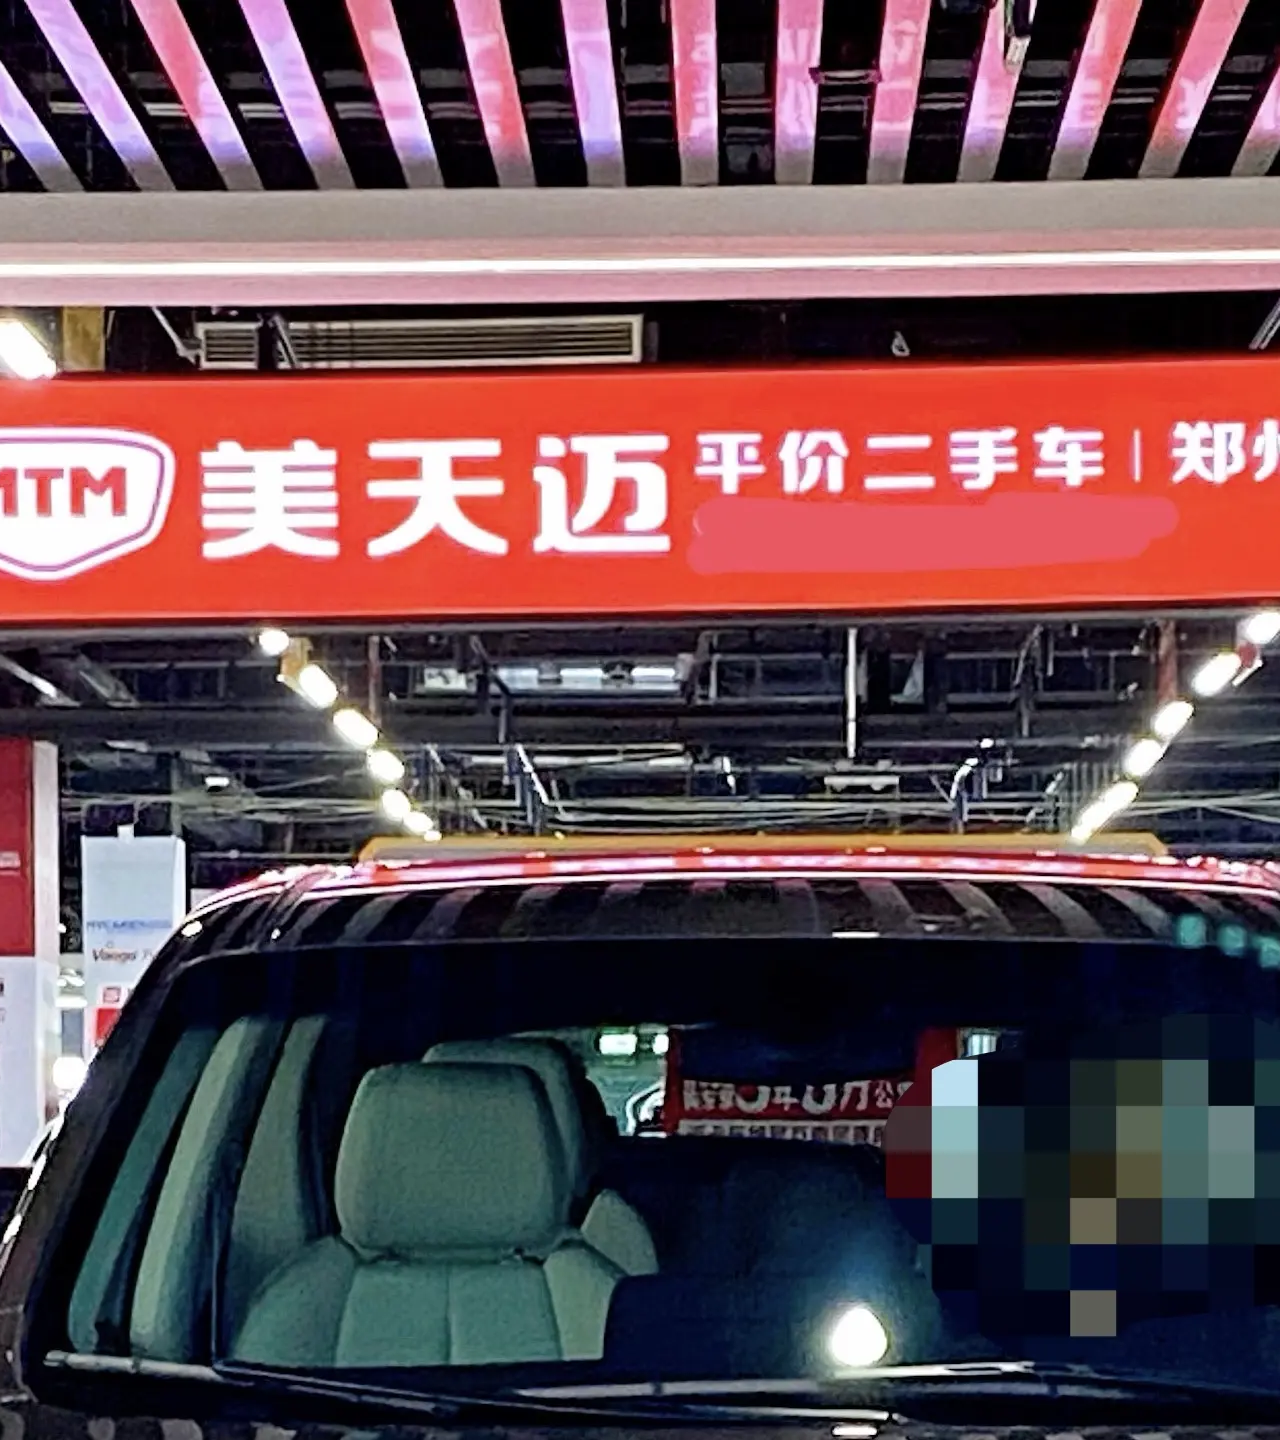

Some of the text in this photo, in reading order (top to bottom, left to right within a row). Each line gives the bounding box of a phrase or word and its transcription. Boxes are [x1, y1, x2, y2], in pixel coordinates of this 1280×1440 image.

[199, 436, 670, 560] 美天迈
[694, 425, 1106, 494] 平价二手车
